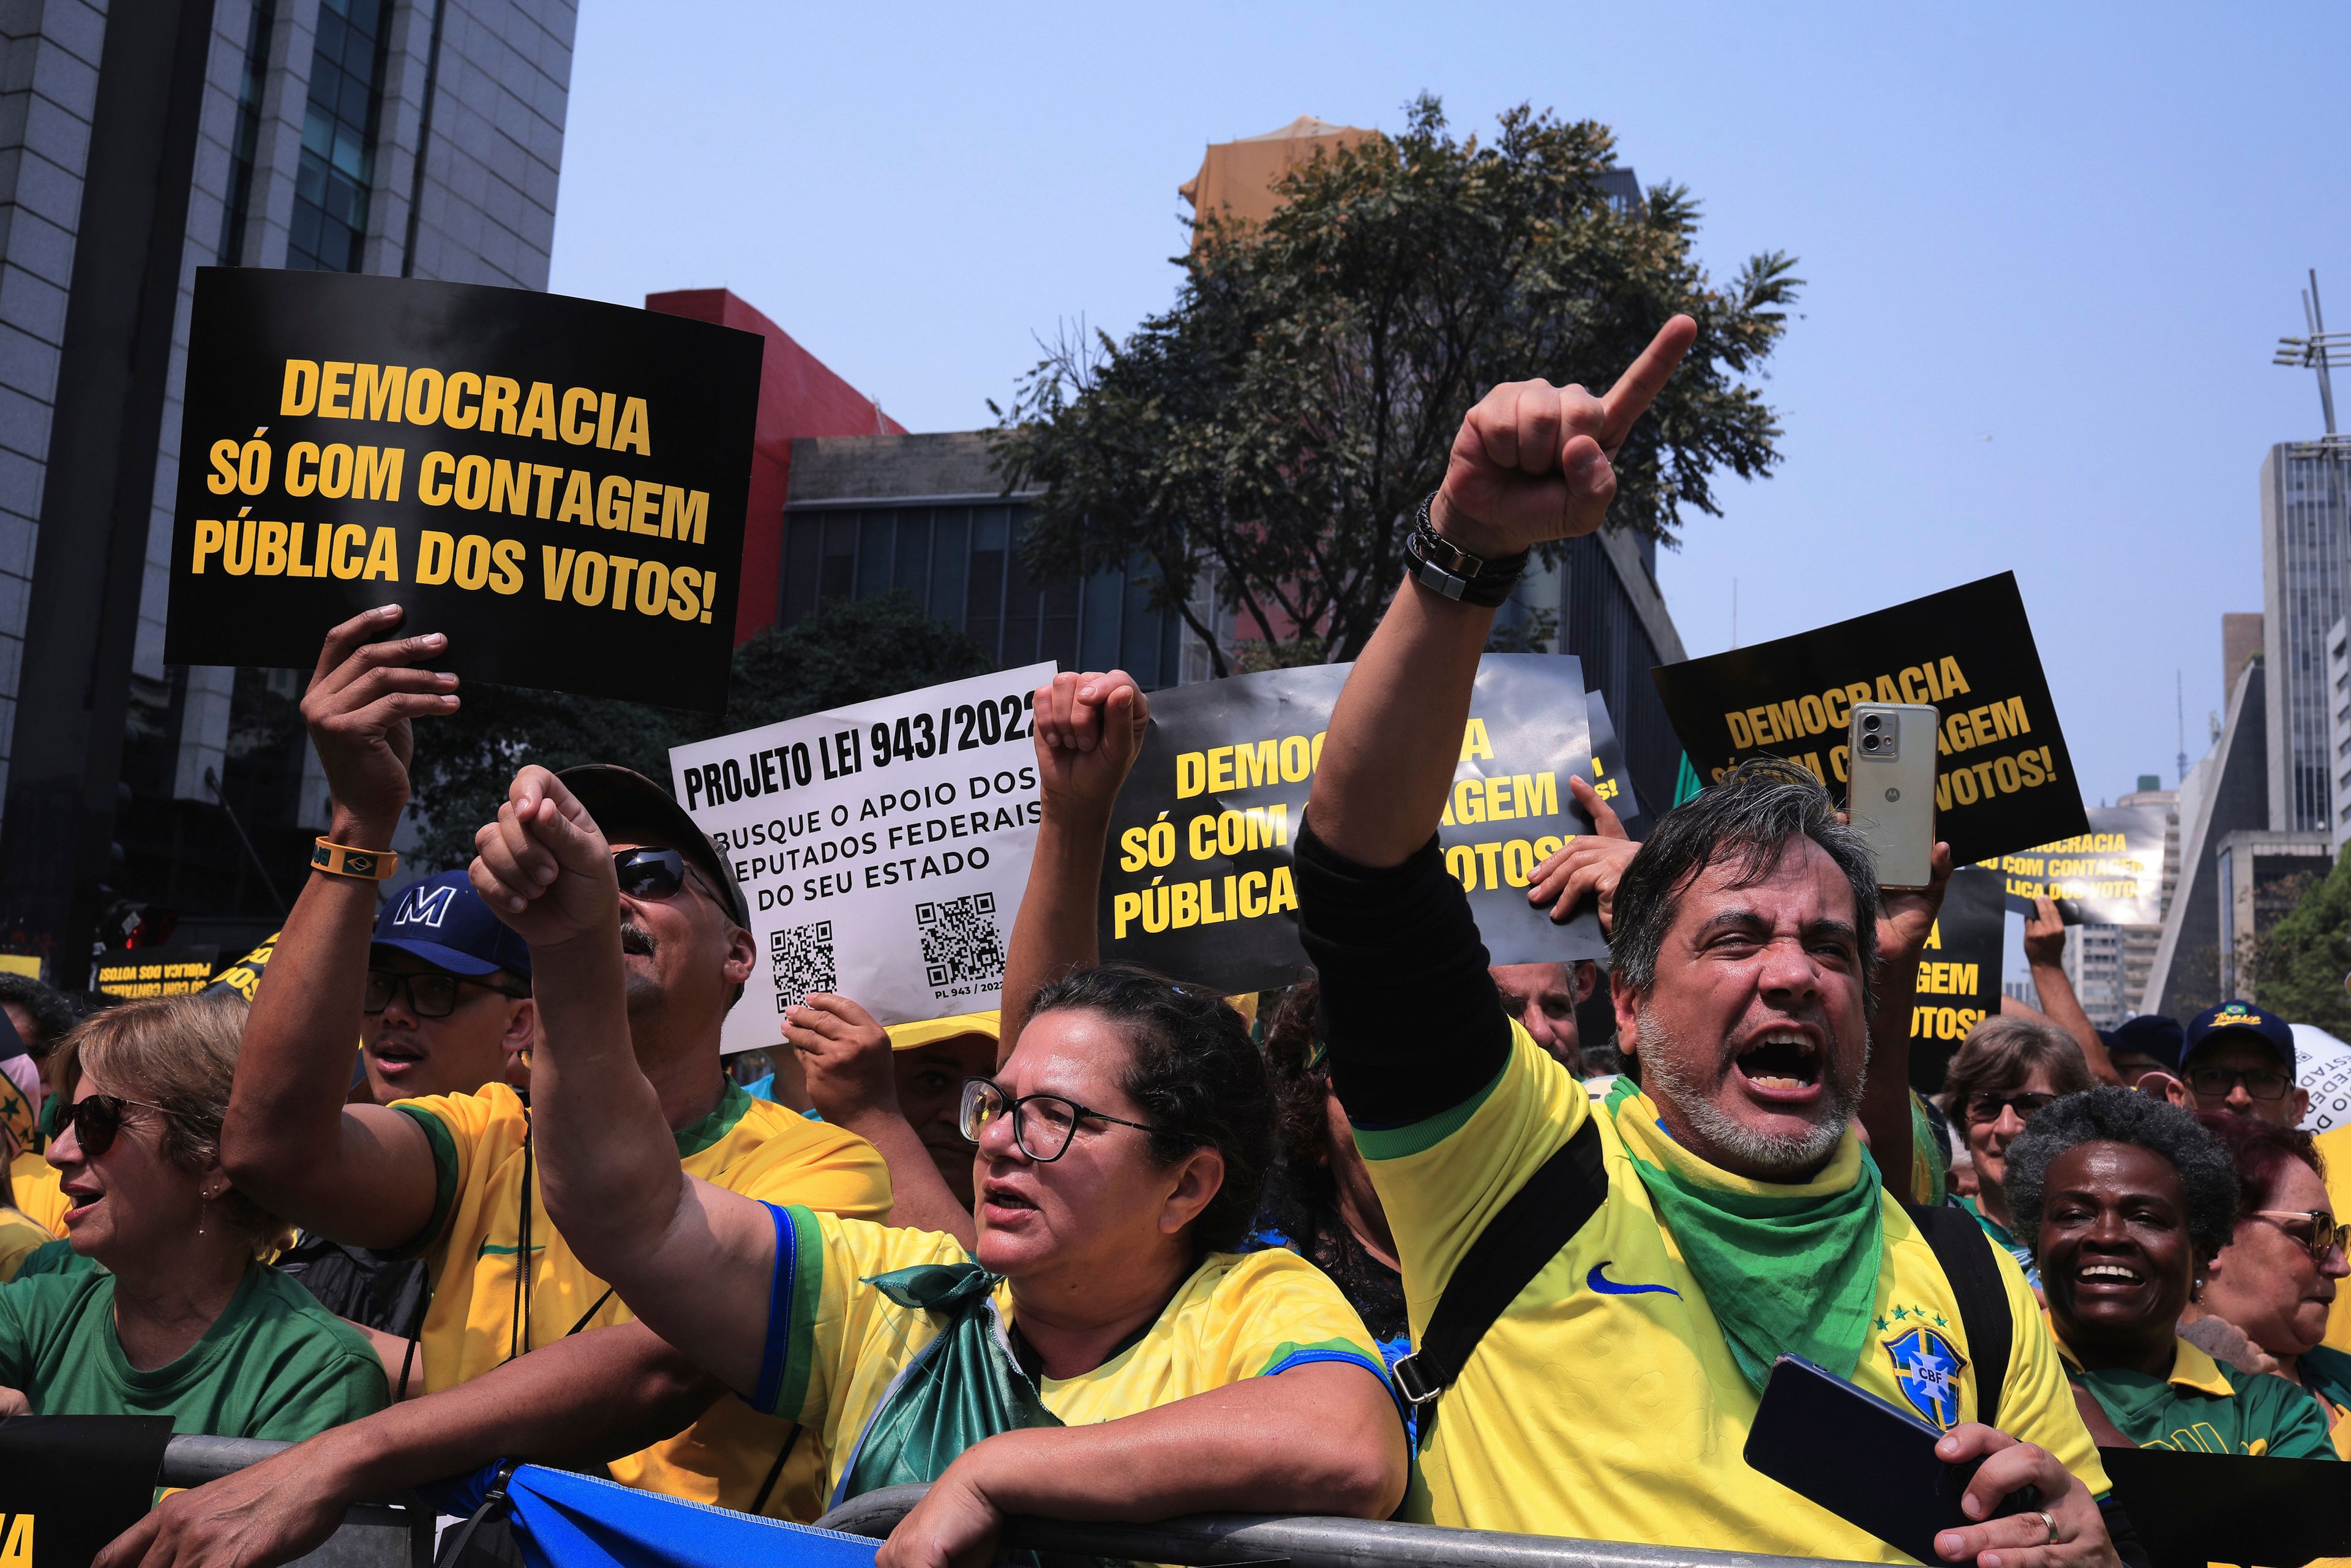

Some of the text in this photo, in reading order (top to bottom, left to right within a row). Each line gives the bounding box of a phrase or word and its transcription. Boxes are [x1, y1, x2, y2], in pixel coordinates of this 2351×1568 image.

[280, 359, 651, 457] DEMOCRACIA
[207, 426, 710, 545] SÓ COM CONTAGEM
[192, 506, 718, 625] PÚBLICA DOS VOTOS!
[1725, 655, 1971, 749] DEMOCRACIA
[683, 741, 812, 811] PROJETO
[819, 729, 861, 781] LEI
[1829, 695, 2031, 783] CGEM
[713, 767, 1036, 852] BUSQUE O APOIO DOS
[1936, 745, 2057, 812] VOTOS!
[735, 800, 1041, 883] EPUTADOS FEDERAIS
[1120, 811, 1176, 872] SÓ
[1188, 803, 1288, 861] COM
[2002, 855, 2044, 877] COM
[2024, 833, 2127, 853] OCRACIA
[393, 886, 457, 928] M
[758, 846, 990, 912] DO SEU ESTADO
[1114, 865, 1299, 939] PÚBLICA
[2006, 878, 2045, 900] LICA
[99, 962, 212, 982] PÚBLICA DOS VOTOS!
[935, 990, 949, 999] PL
[951, 986, 971, 997] 943
[974, 983, 978, 994] /
[1919, 1367, 1942, 1384] CBF
